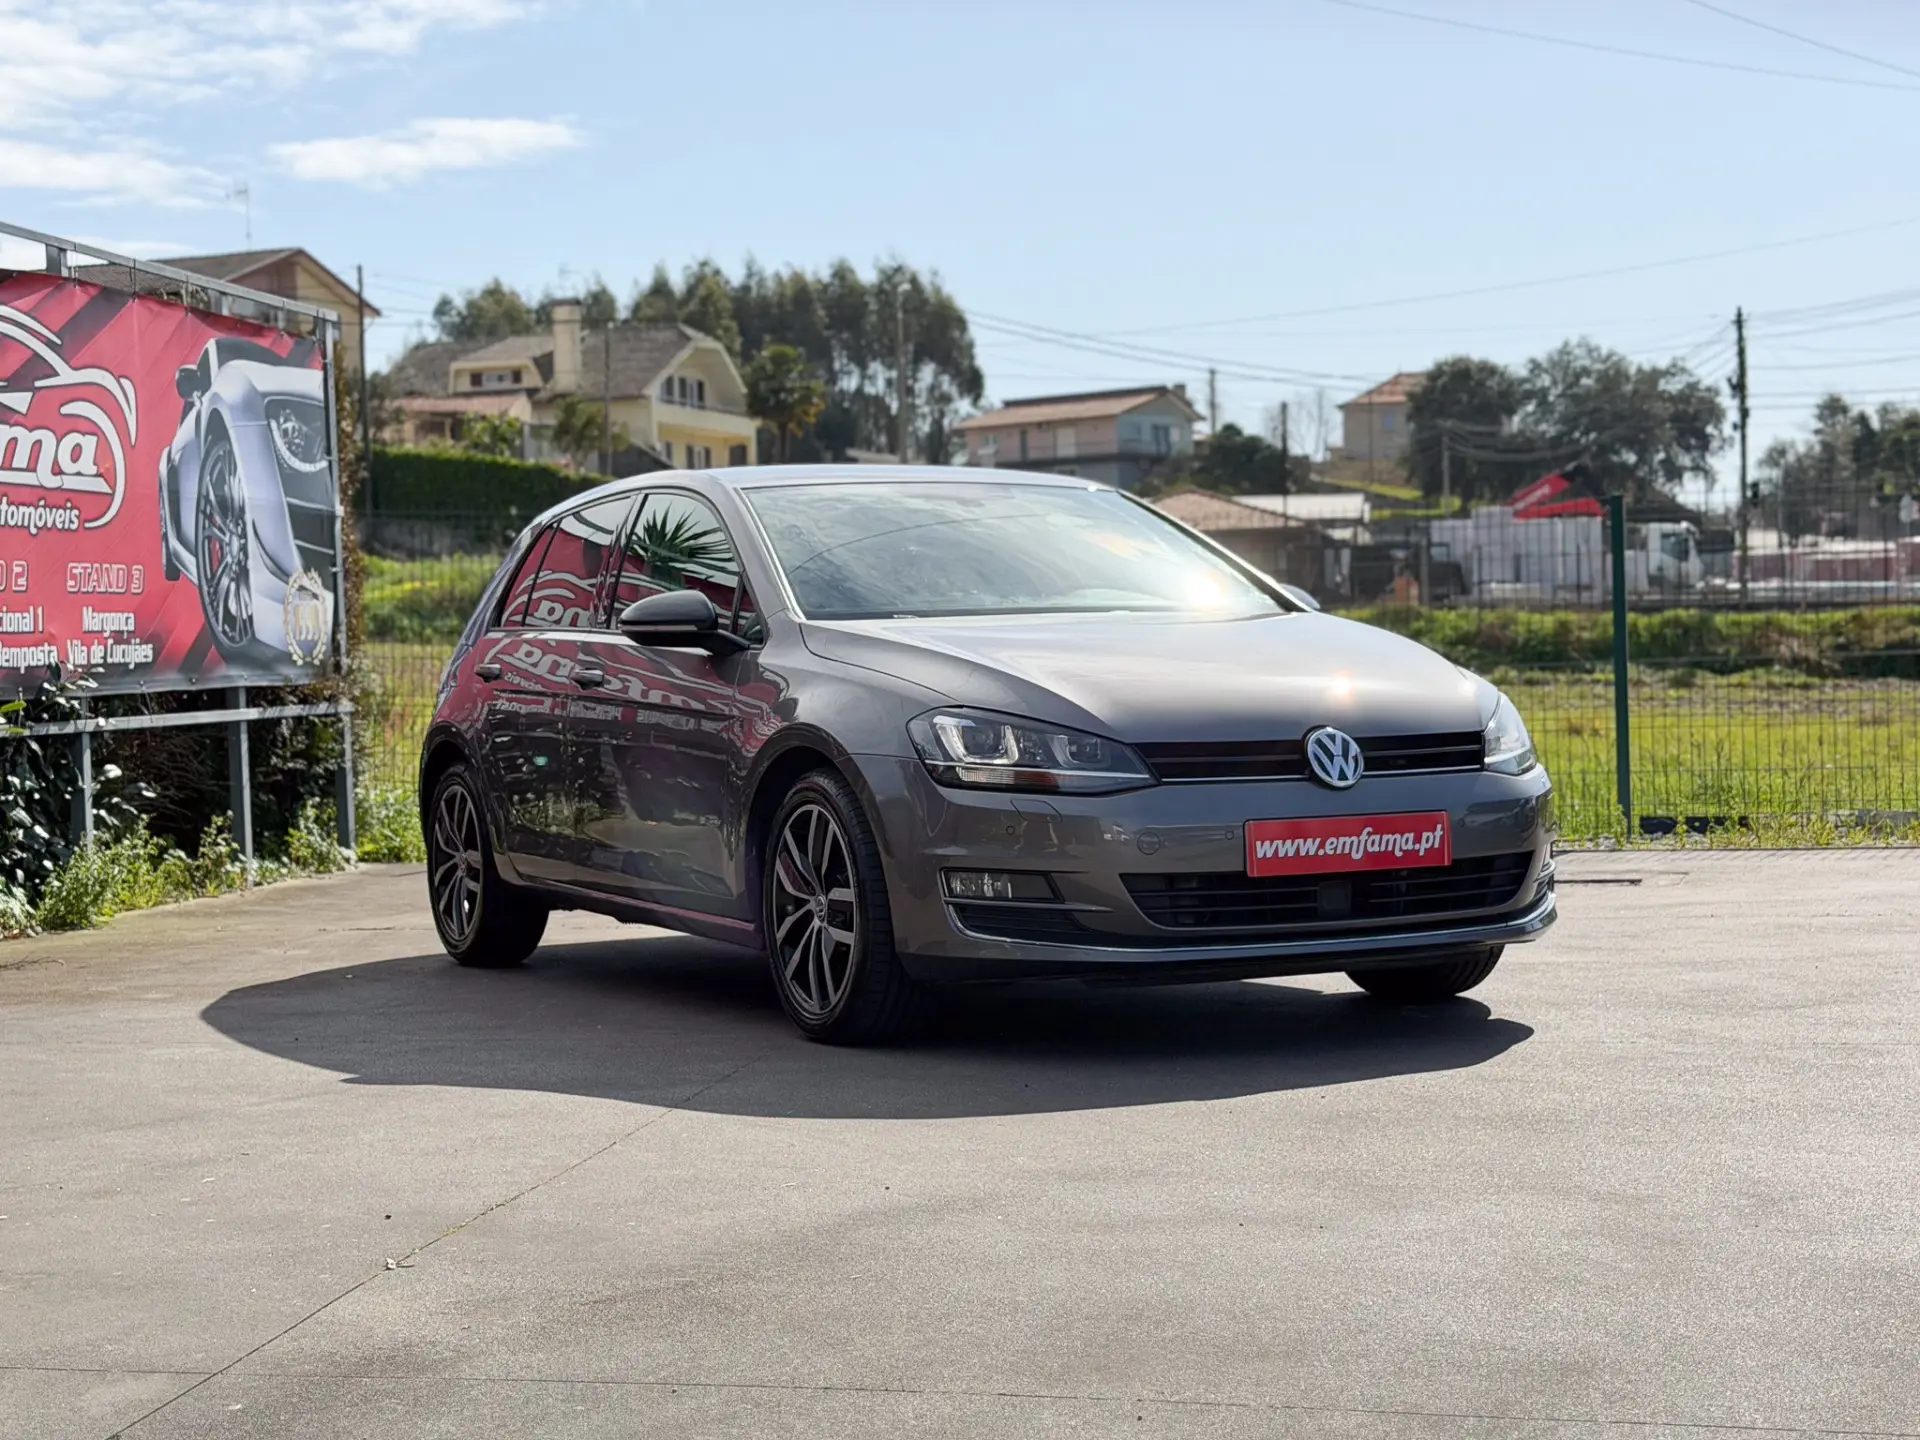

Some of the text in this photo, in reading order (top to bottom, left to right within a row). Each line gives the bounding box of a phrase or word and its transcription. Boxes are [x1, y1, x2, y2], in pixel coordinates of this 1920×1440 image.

[12, 560, 28, 591] 2
[66, 562, 144, 594] STAND 3
[82, 606, 135, 640] Margonça
[66, 639, 88, 665] Vila
[90, 639, 105, 664] de
[1255, 823, 1444, 860] www.emfama.pt
